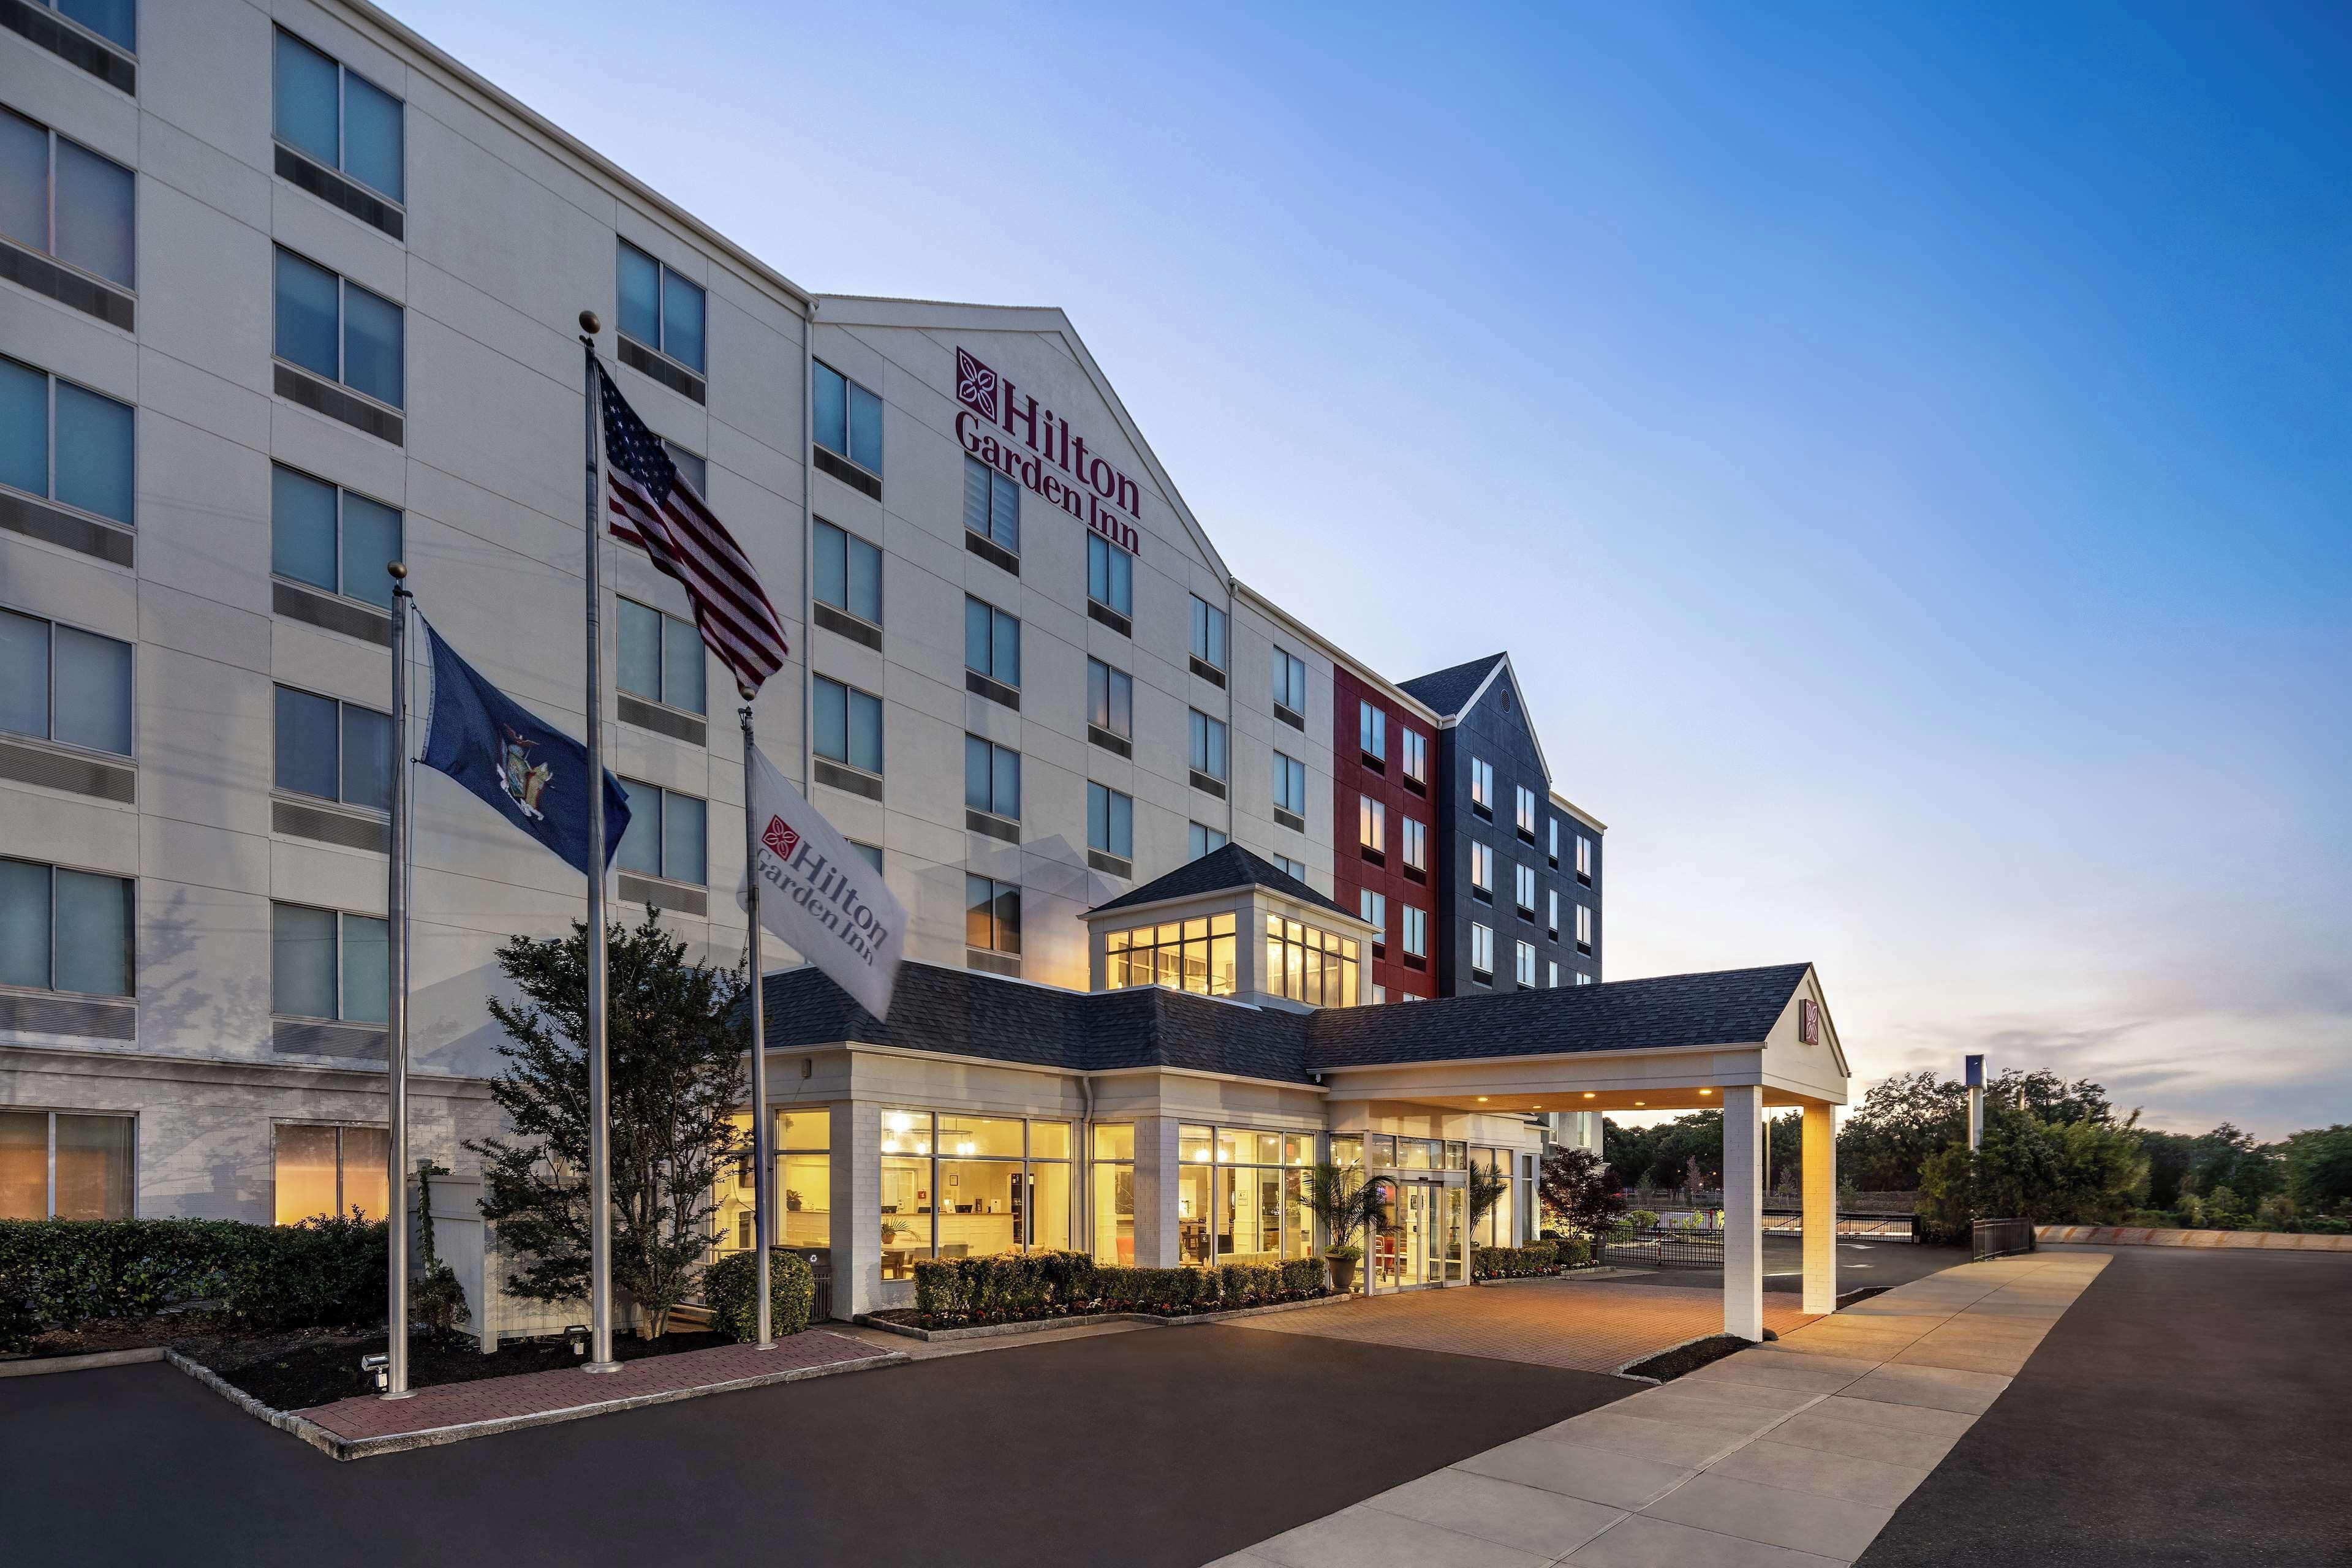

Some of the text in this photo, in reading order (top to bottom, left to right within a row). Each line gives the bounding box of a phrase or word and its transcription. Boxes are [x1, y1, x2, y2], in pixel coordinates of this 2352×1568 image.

[955, 410, 1141, 557] Garden Inn
[1002, 377, 1141, 519] Hilton
[789, 840, 888, 951] Hilton
[838, 921, 872, 967] Inn
